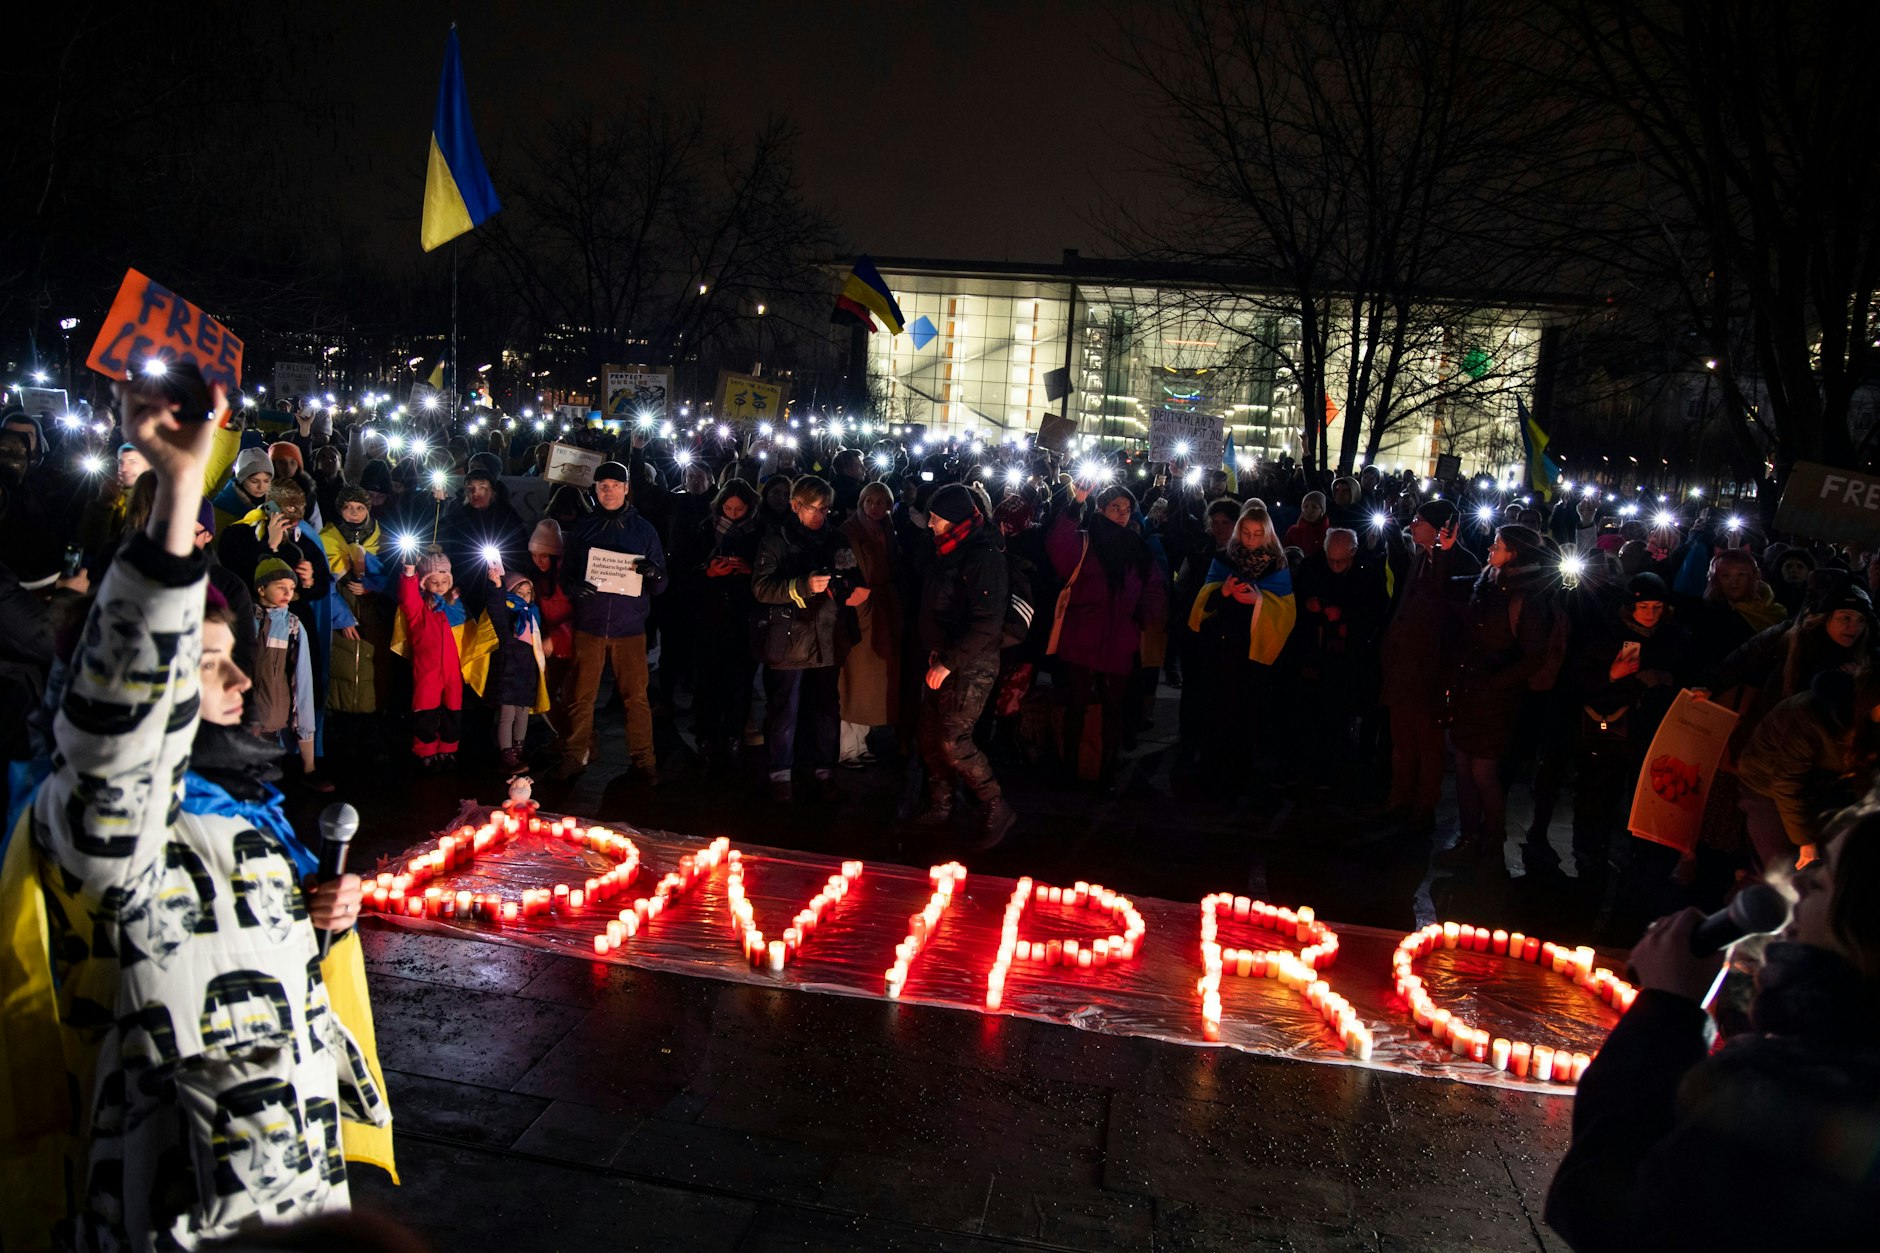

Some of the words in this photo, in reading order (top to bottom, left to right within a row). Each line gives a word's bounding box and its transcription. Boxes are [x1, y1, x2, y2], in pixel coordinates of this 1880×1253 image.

[139, 280, 241, 366] FREE
[1153, 409, 1215, 428] DEUTSCHLAND
[1820, 474, 1880, 511] FRE
[600, 569, 627, 578] zukünftige
[359, 808, 1640, 1085] DNIPRO
